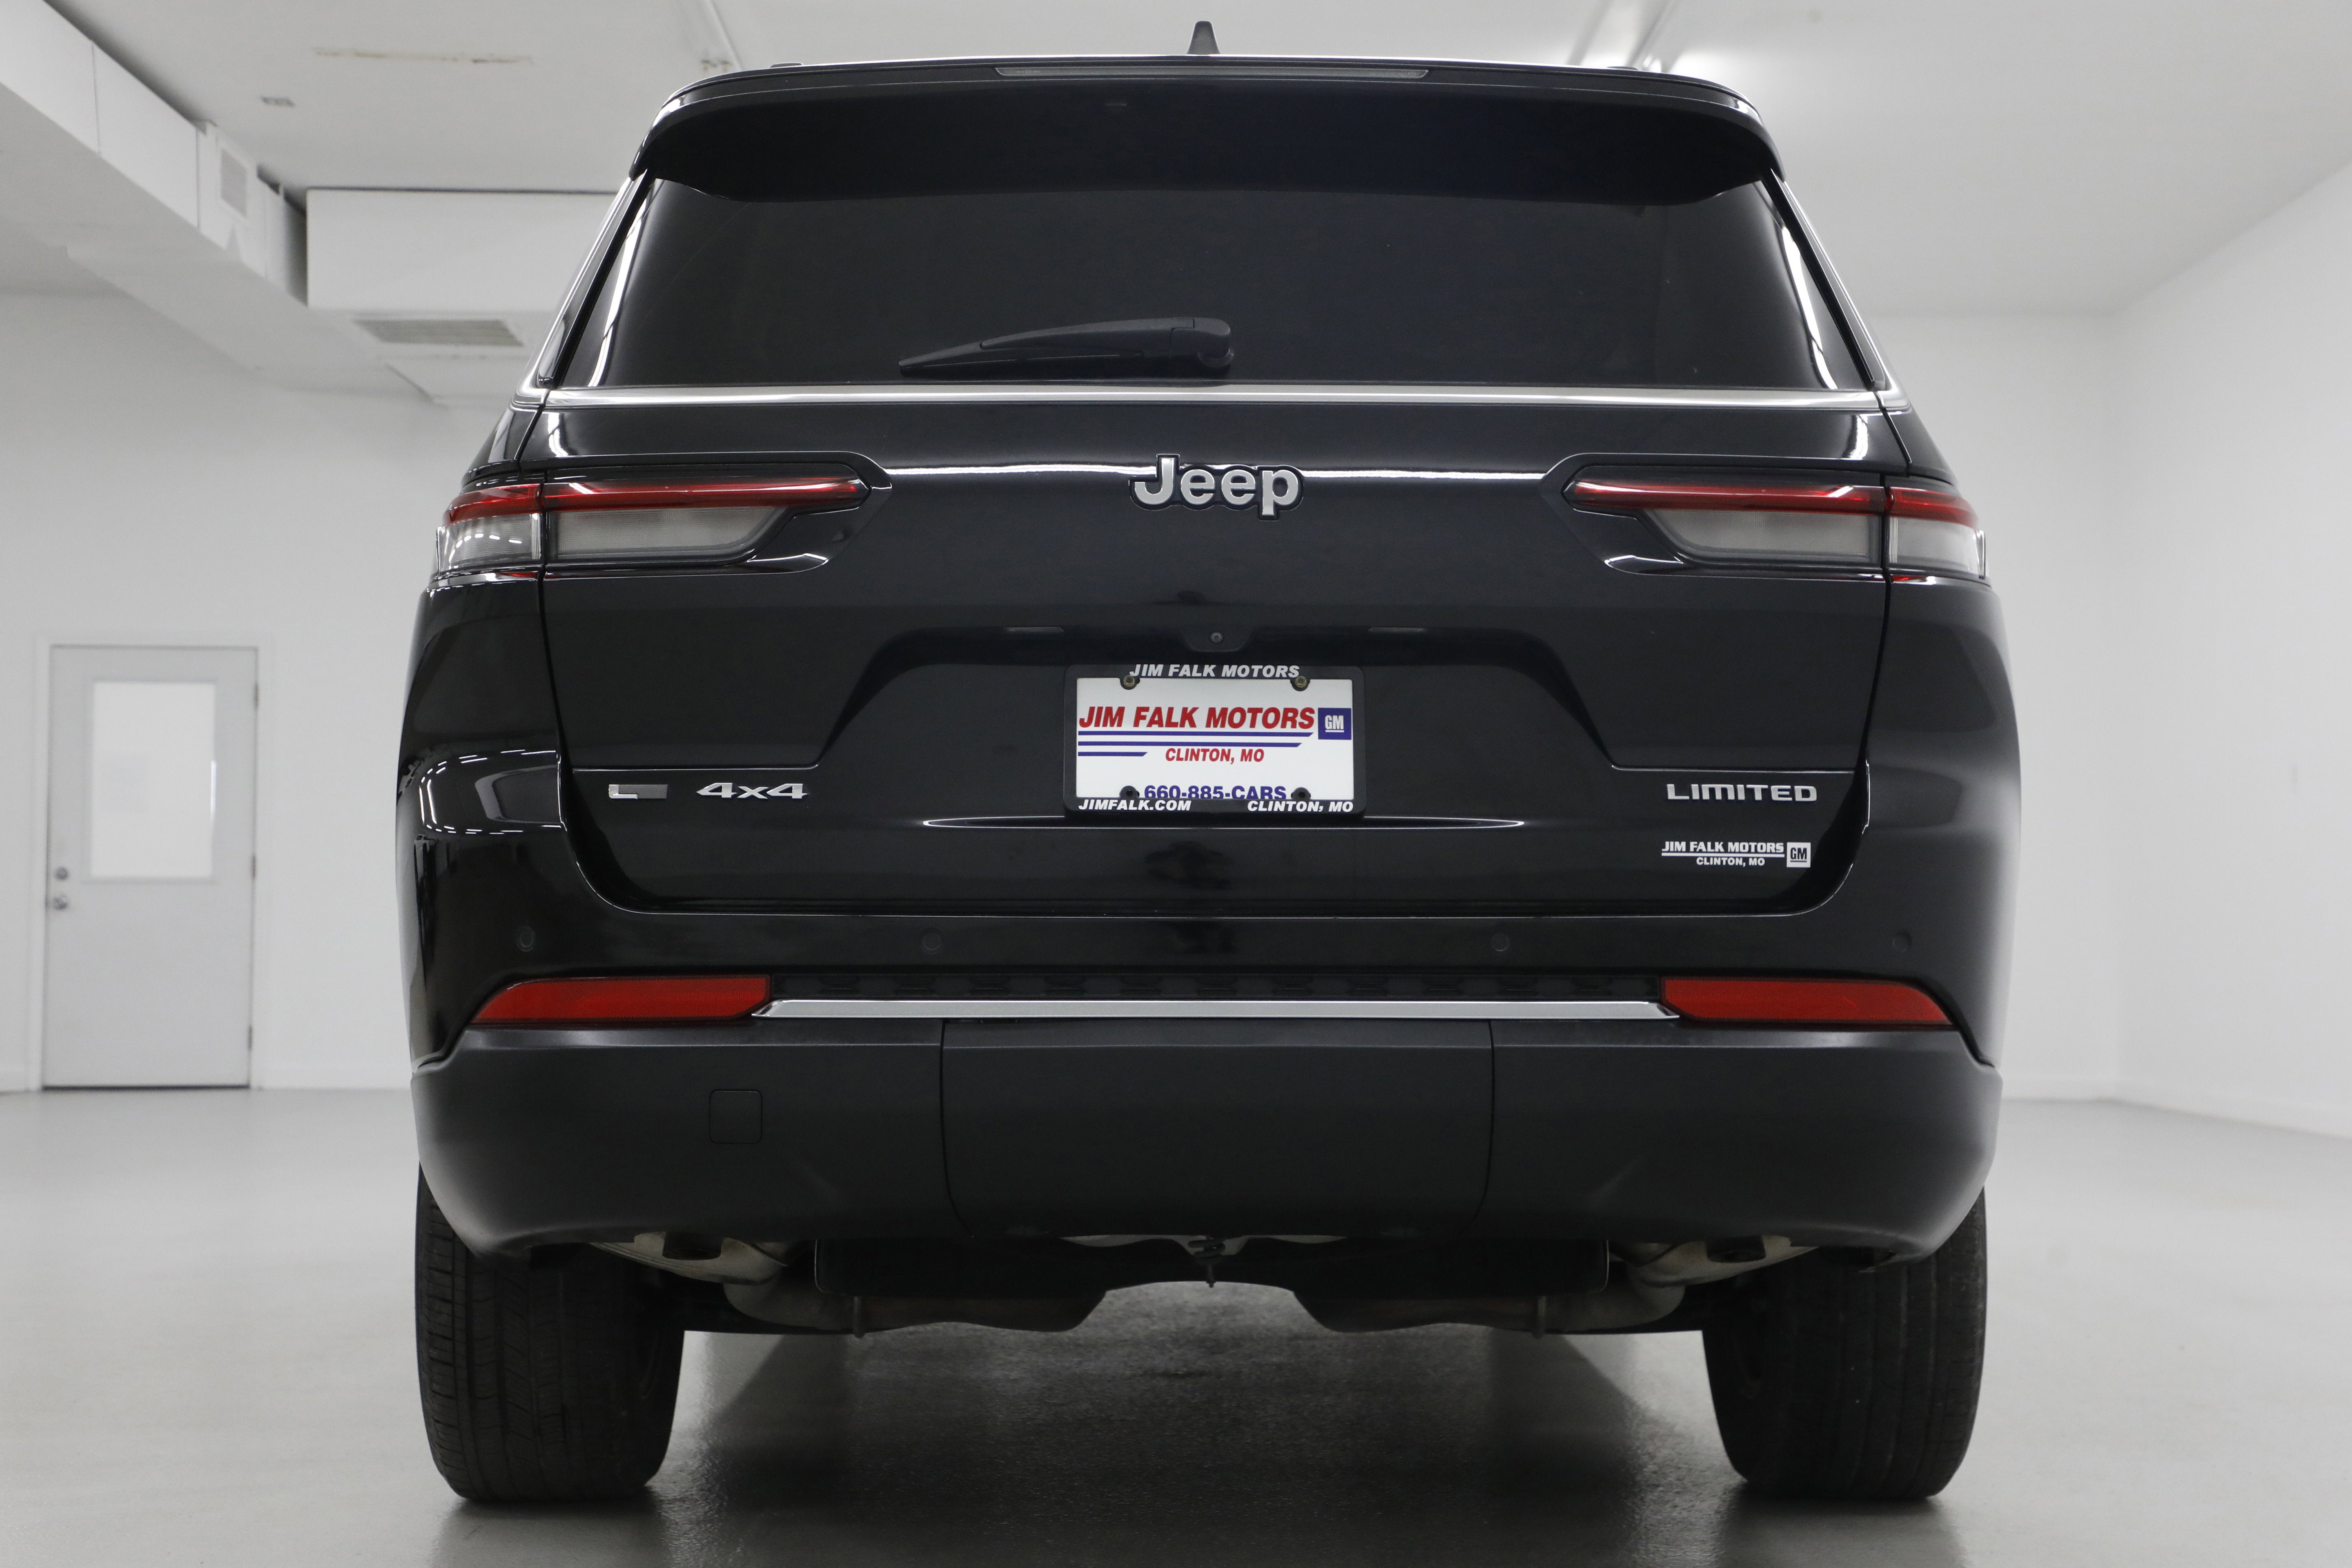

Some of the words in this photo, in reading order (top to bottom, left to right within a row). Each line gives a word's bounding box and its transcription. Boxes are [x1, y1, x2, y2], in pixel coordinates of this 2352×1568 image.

[1134, 457, 1299, 516] Jeep
[1129, 664, 1163, 677] JIM
[1168, 664, 1217, 677] FALK
[1221, 665, 1300, 678] MOTORS
[1079, 706, 1125, 728] JIM
[1133, 706, 1199, 728] FALK
[1206, 707, 1315, 729] MOTORS
[1324, 715, 1345, 730] GM
[1165, 748, 1234, 764] CLINTON,
[1240, 748, 1265, 762] MO
[696, 782, 809, 799] 4x4
[1144, 785, 1287, 800] 660-885-CARS
[1666, 784, 1817, 802] LIMITED
[1078, 800, 1192, 811] JIMFALK.COM
[1247, 800, 1323, 812] CLINTON,
[1329, 801, 1354, 813] MO
[1662, 841, 1686, 851] JIM
[1690, 842, 1725, 852] FALK
[1728, 842, 1784, 853] MOTORS
[1790, 847, 1808, 860] GM
[1696, 857, 1746, 867] CLINTON,
[1748, 858, 1765, 866] MO
